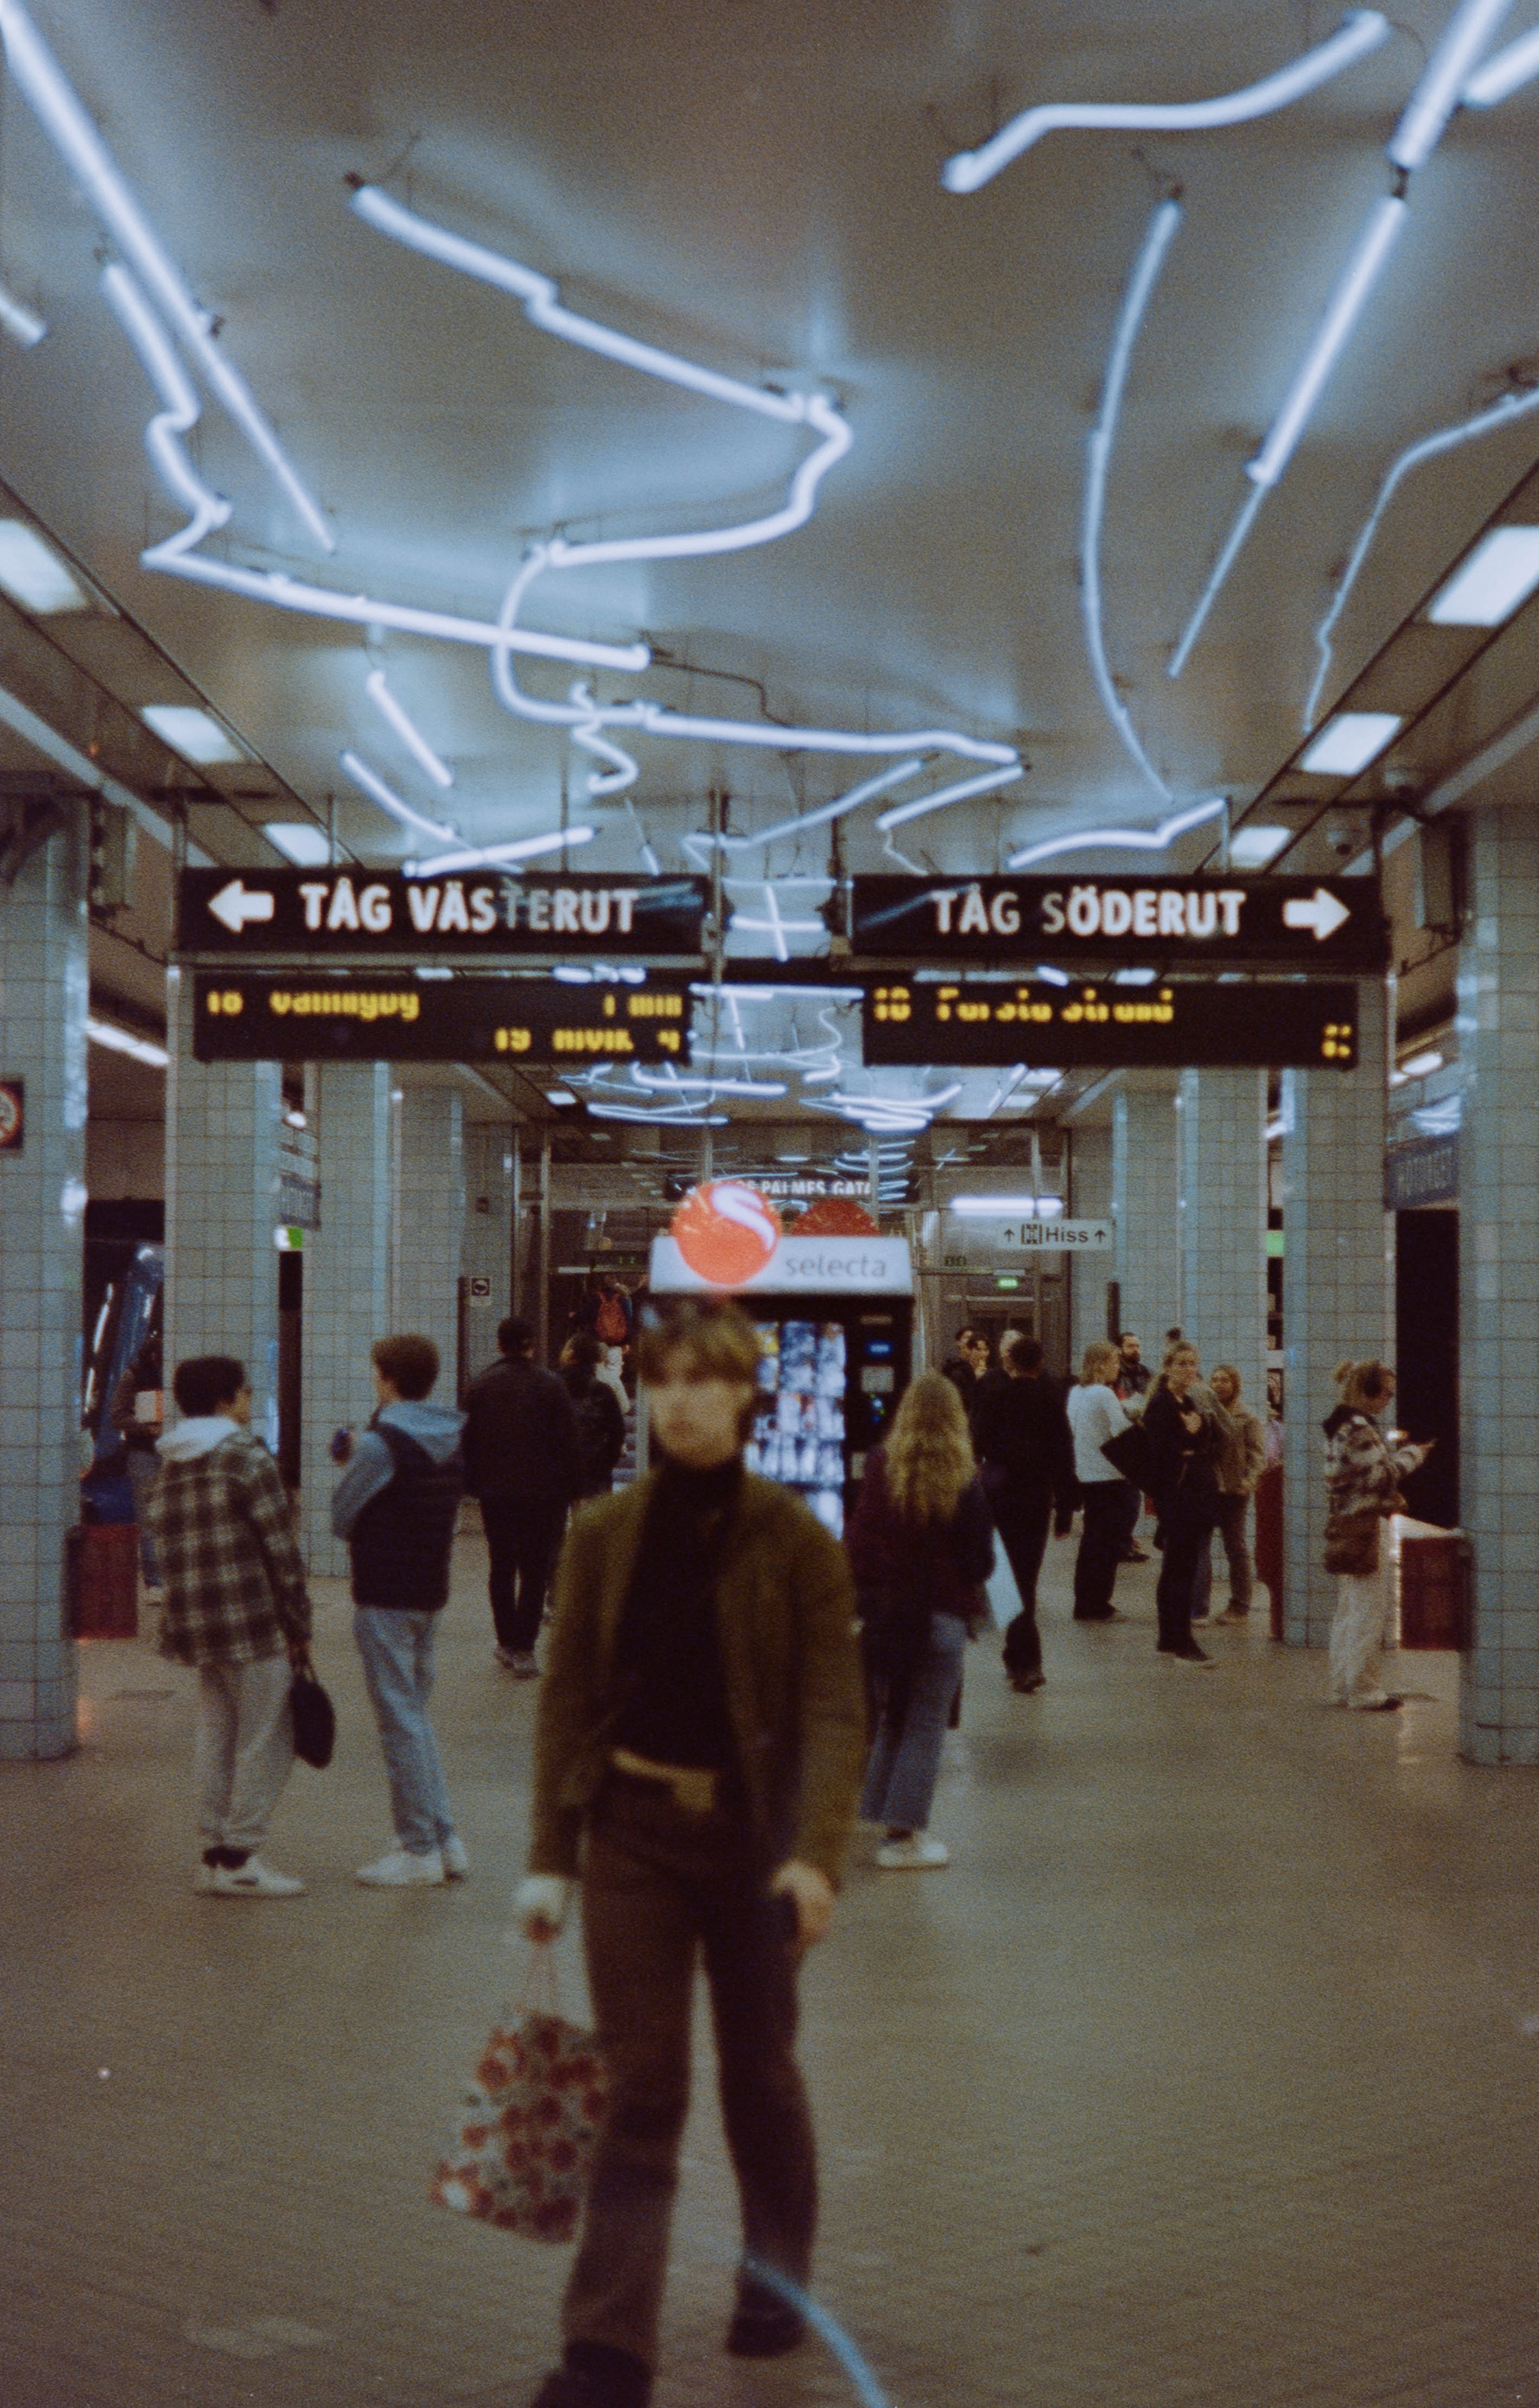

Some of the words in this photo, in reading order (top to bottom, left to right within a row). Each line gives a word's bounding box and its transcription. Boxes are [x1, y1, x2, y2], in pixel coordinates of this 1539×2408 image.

[299, 877, 391, 932] TÅG
[407, 881, 640, 934] VÄSTERUT
[931, 882, 1021, 934] TÅG
[1042, 885, 1247, 937] SÖDERUT
[1045, 1226, 1089, 1243] Hiss
[785, 1254, 887, 1277] selecta
